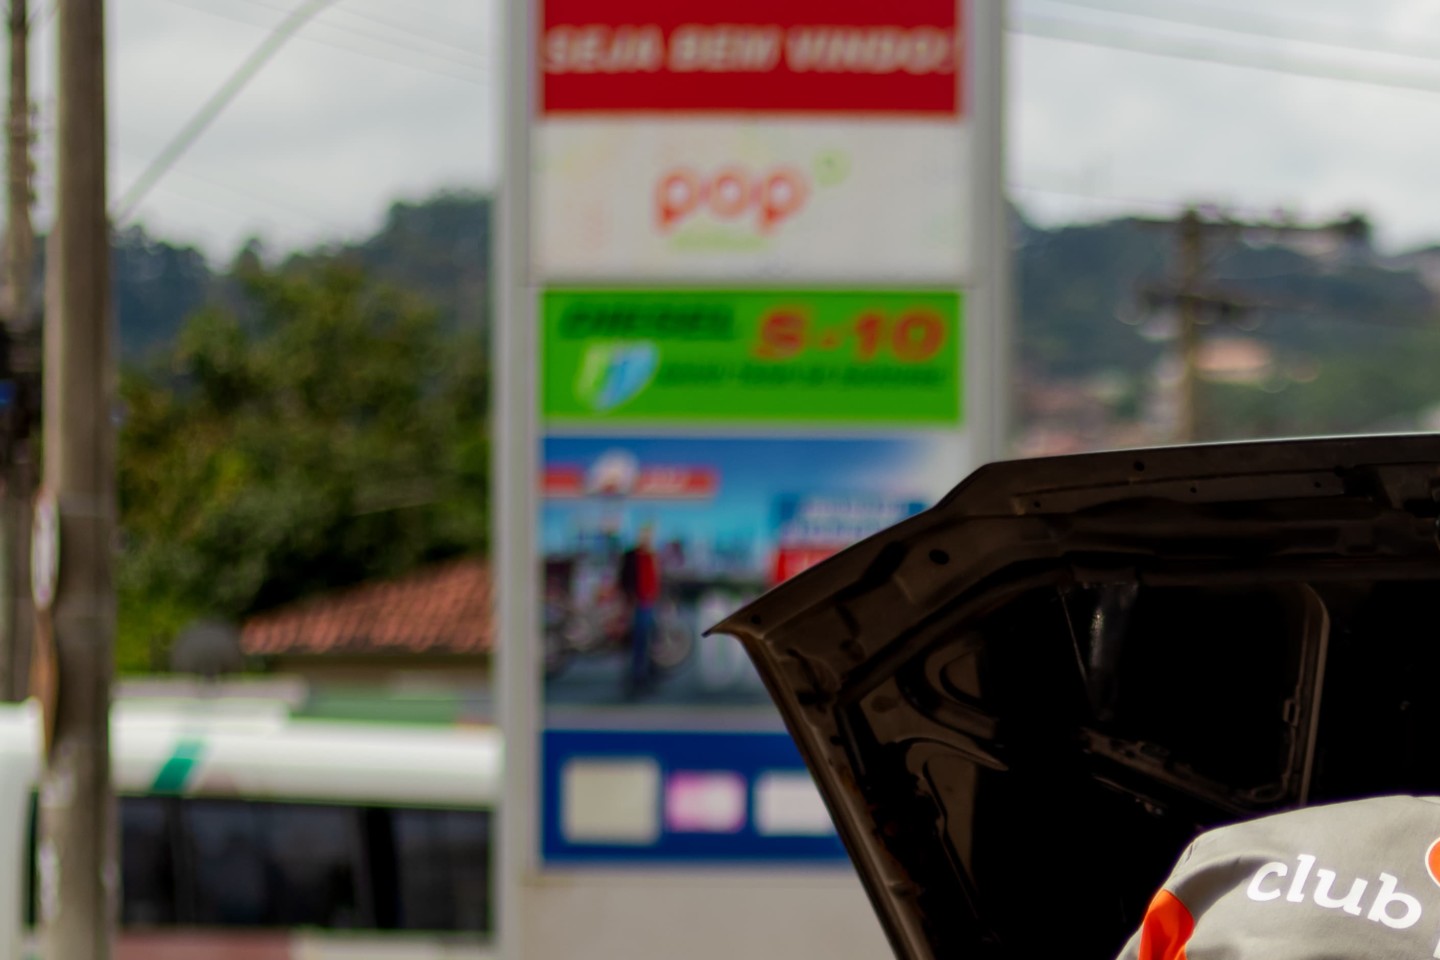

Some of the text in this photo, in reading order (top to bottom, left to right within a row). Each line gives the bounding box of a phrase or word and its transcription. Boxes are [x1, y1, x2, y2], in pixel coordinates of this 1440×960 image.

[546, 24, 663, 73] SEJA
[668, 24, 783, 72] BEM
[655, 166, 807, 235] pop
[752, 304, 947, 363] S-10
[1246, 854, 1423, 930] club
